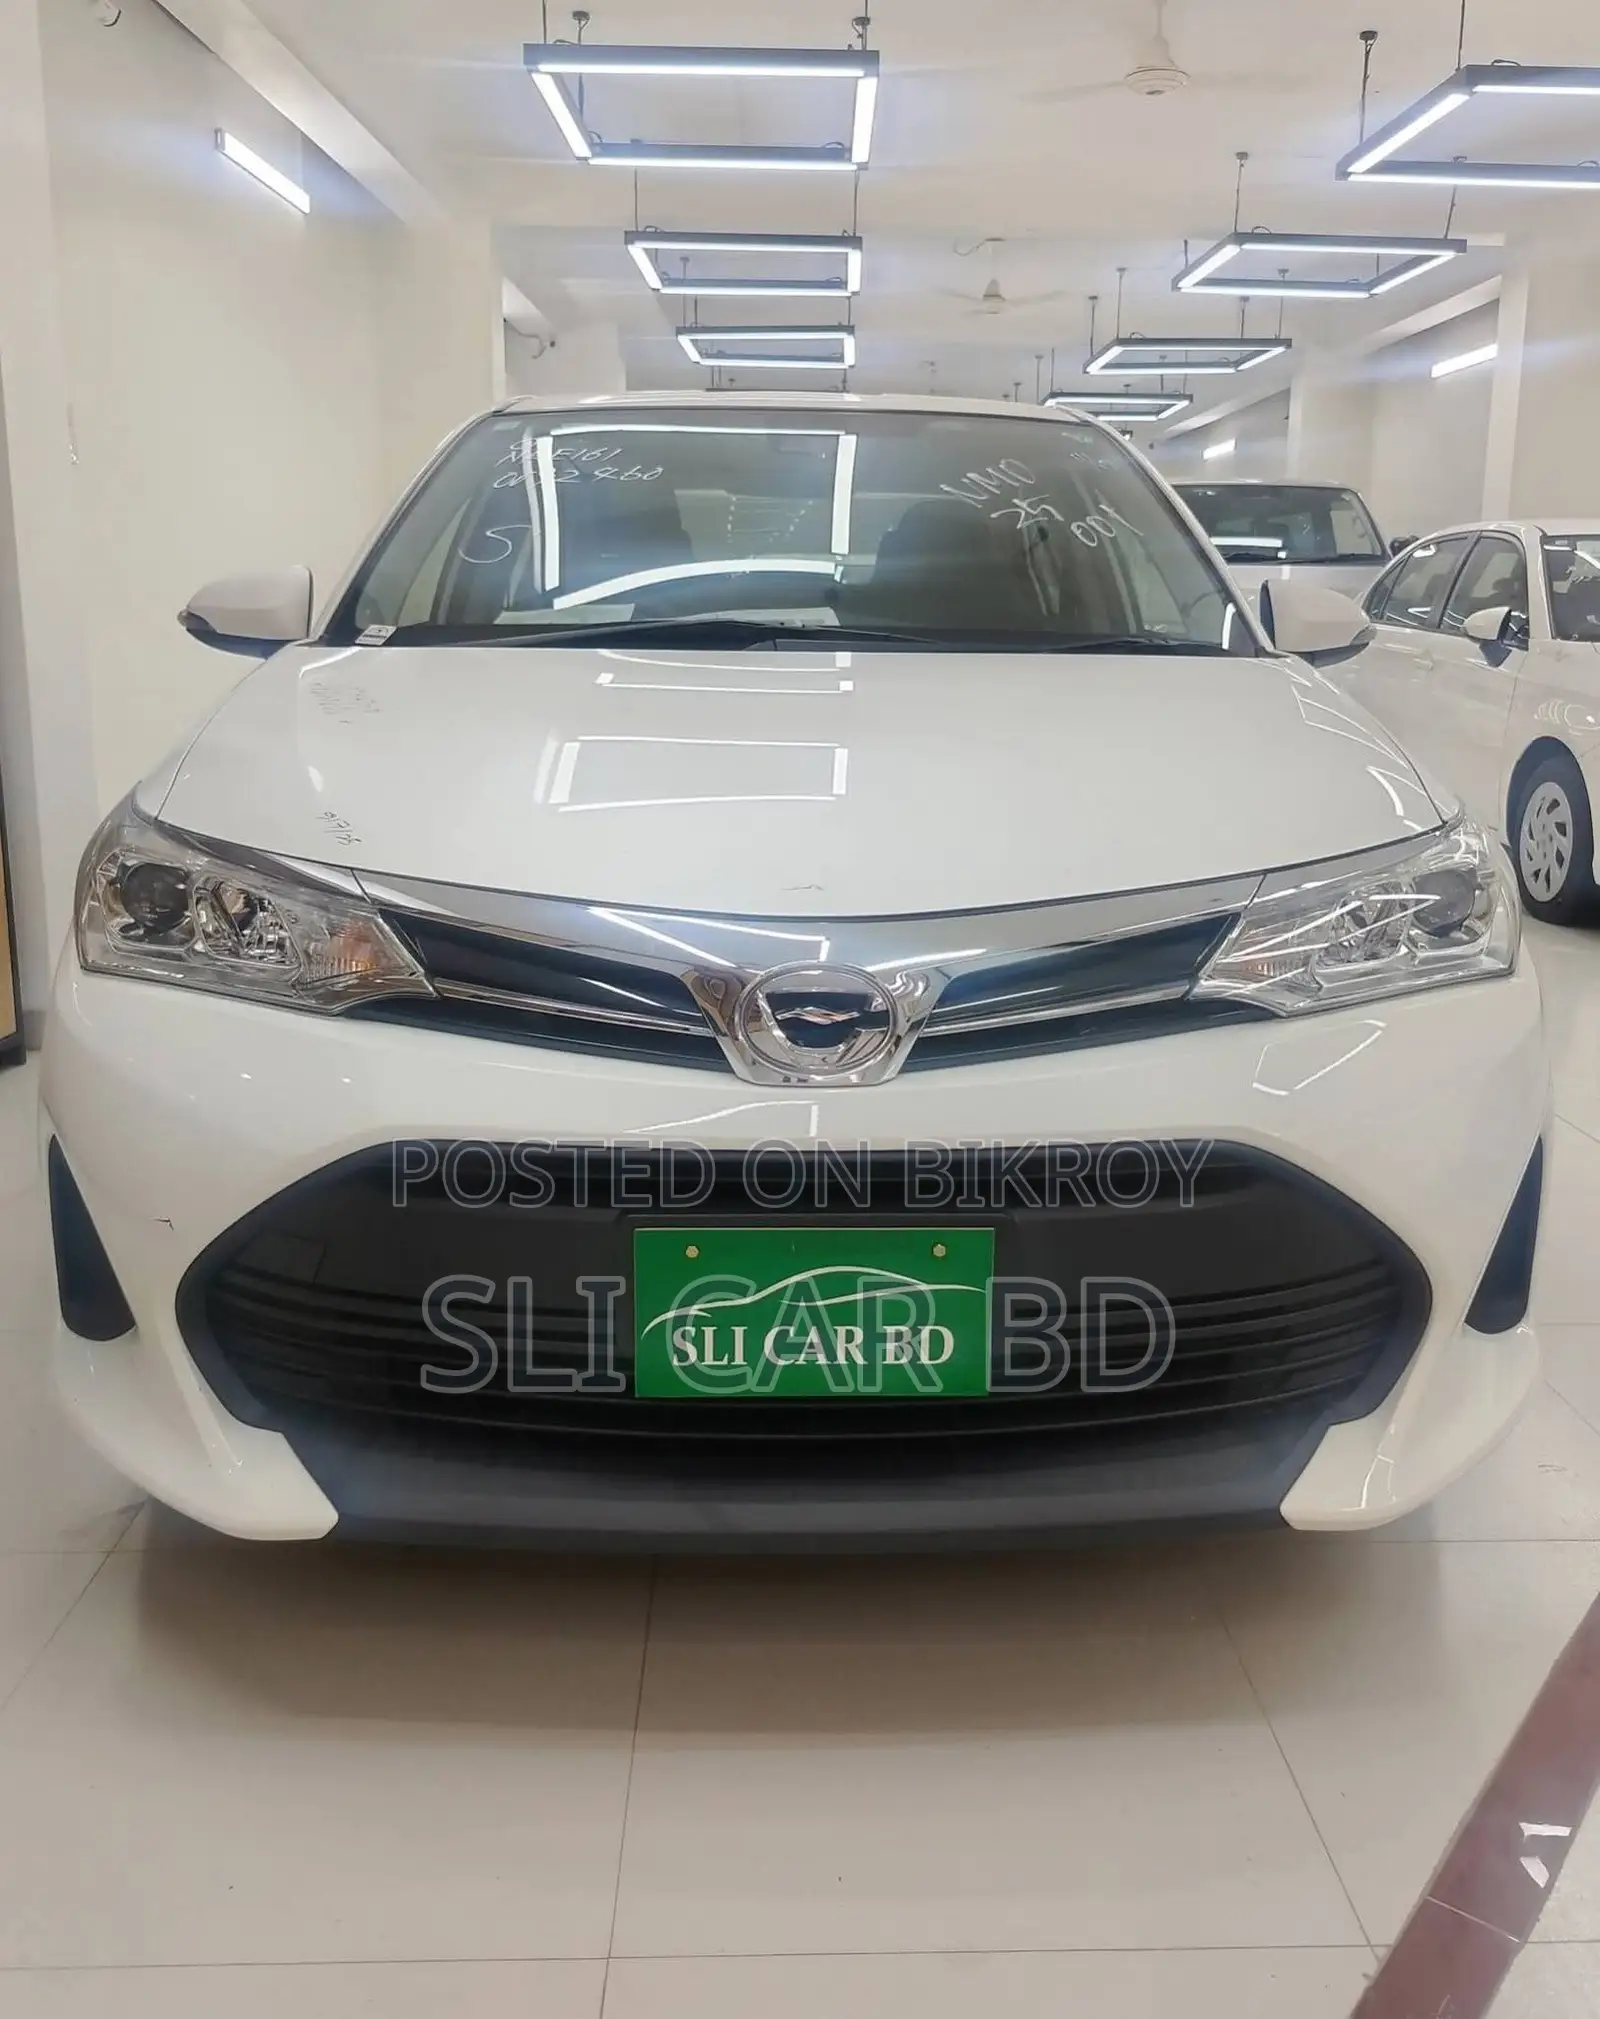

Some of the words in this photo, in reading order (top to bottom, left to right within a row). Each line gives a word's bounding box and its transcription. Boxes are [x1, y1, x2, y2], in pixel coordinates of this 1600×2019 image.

[672, 1325, 748, 1366] SLI
[763, 1325, 868, 1366] CAR
[882, 1325, 955, 1366] BD
